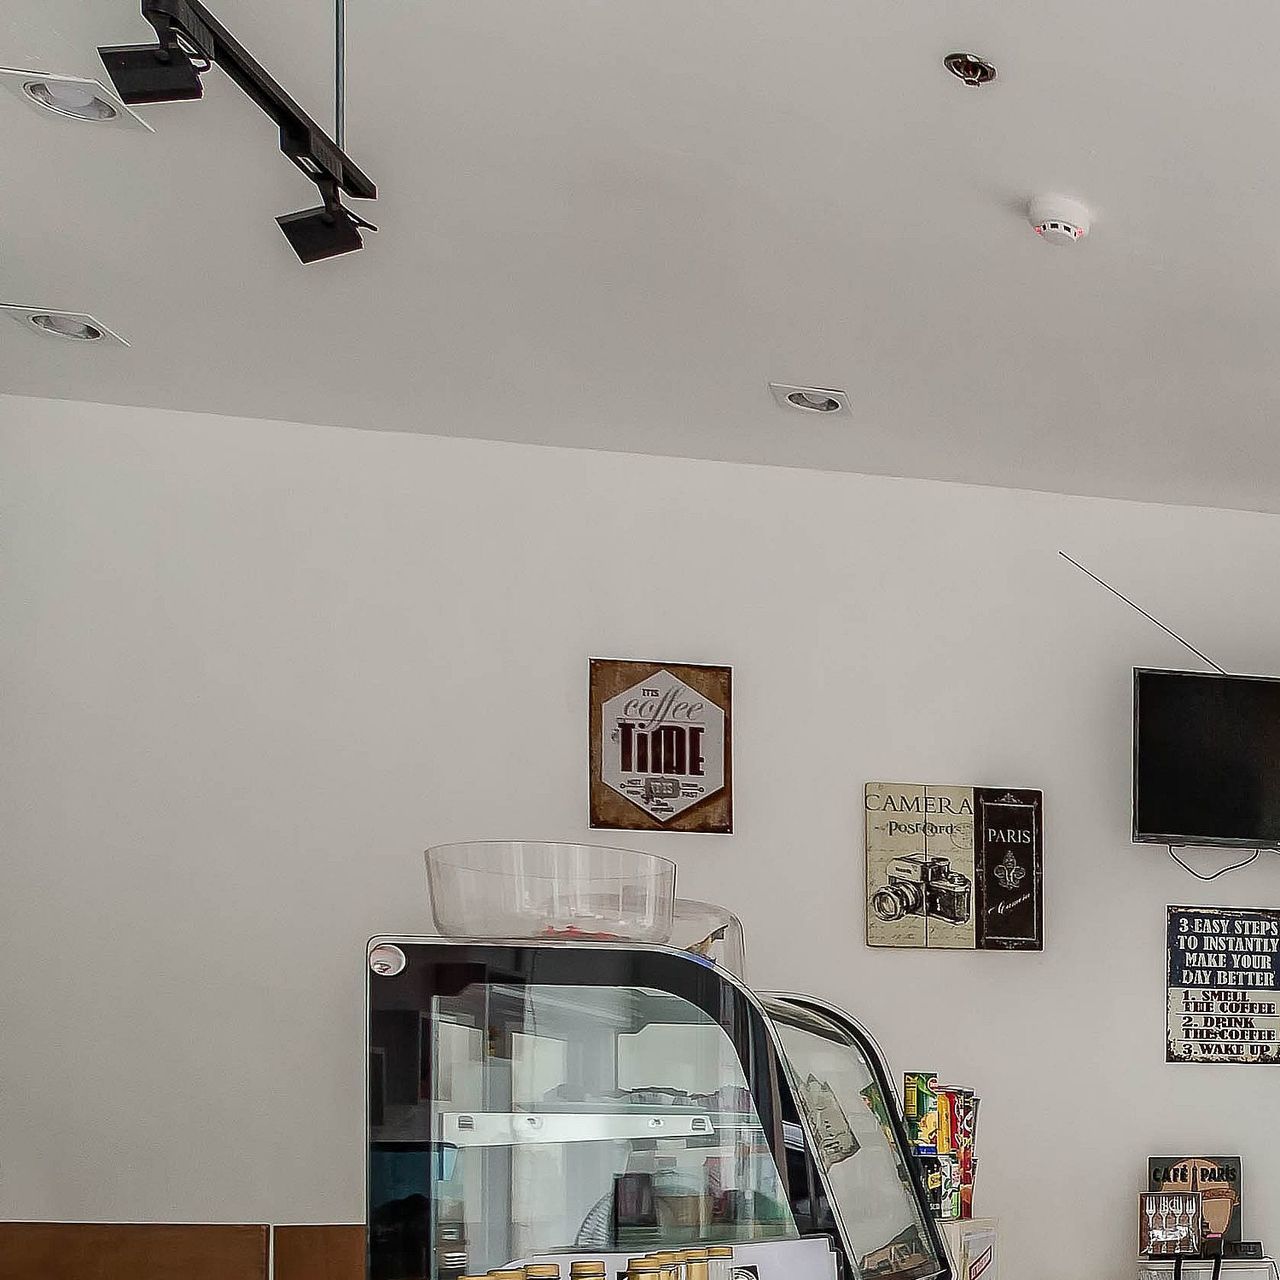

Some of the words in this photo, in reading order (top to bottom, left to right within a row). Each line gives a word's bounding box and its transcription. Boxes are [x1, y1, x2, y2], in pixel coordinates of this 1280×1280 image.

[623, 684, 704, 731] coffee
[865, 794, 974, 815] CAMERA
[988, 828, 1031, 843] PARIS
[1179, 917, 1189, 933] 3
[1193, 918, 1230, 934] EASY
[1234, 920, 1279, 936] STEPS
[1177, 935, 1198, 950] TO
[1203, 936, 1279, 953] INSTANTLY
[1185, 952, 1227, 968] MAKE
[1231, 954, 1272, 969] YOUR
[1182, 970, 1212, 985] DAY
[1216, 971, 1275, 987] BETTER
[1219, 1002, 1276, 1014] COFFEE
[1203, 1016, 1255, 1028] DRINK
[1199, 1044, 1244, 1056] WAKE
[1249, 1044, 1271, 1056] UP
[1200, 1165, 1237, 1182] PARIS
